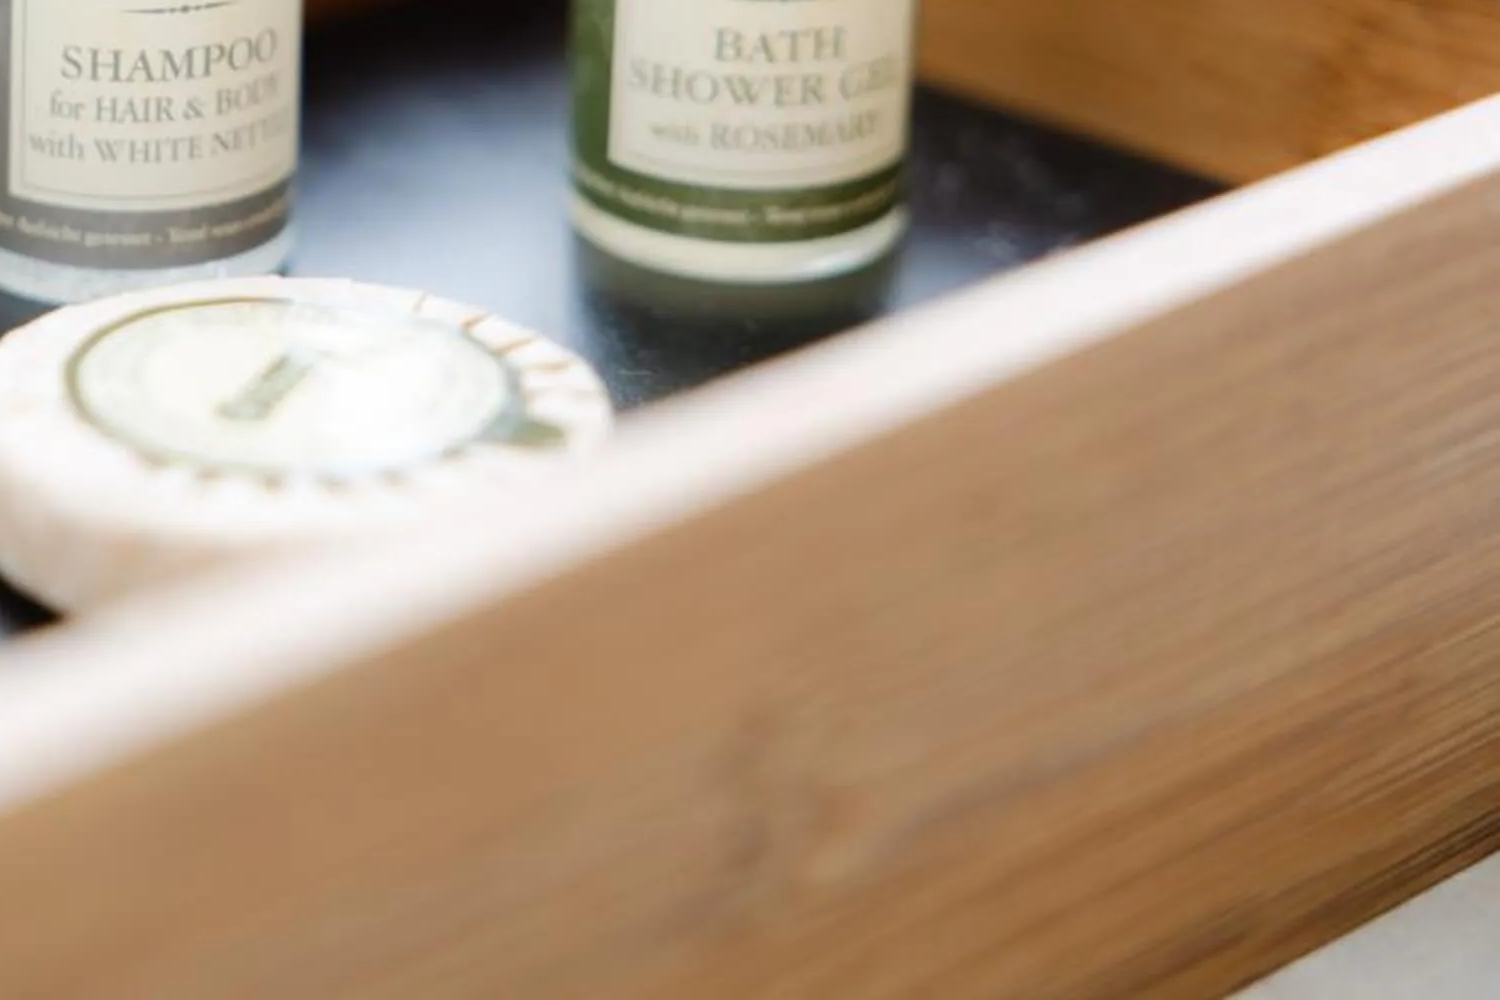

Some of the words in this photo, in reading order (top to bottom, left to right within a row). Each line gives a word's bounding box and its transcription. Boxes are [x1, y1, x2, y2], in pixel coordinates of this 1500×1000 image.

[59, 25, 278, 84] SHAMPOO
[712, 26, 848, 64] BATH
[628, 57, 827, 108] SHOWER
[49, 88, 86, 122] for
[94, 94, 176, 125] HAIR
[181, 96, 207, 122] &
[27, 129, 85, 163] with
[92, 133, 204, 165] WHITE
[708, 107, 881, 152] ROSEMARY
